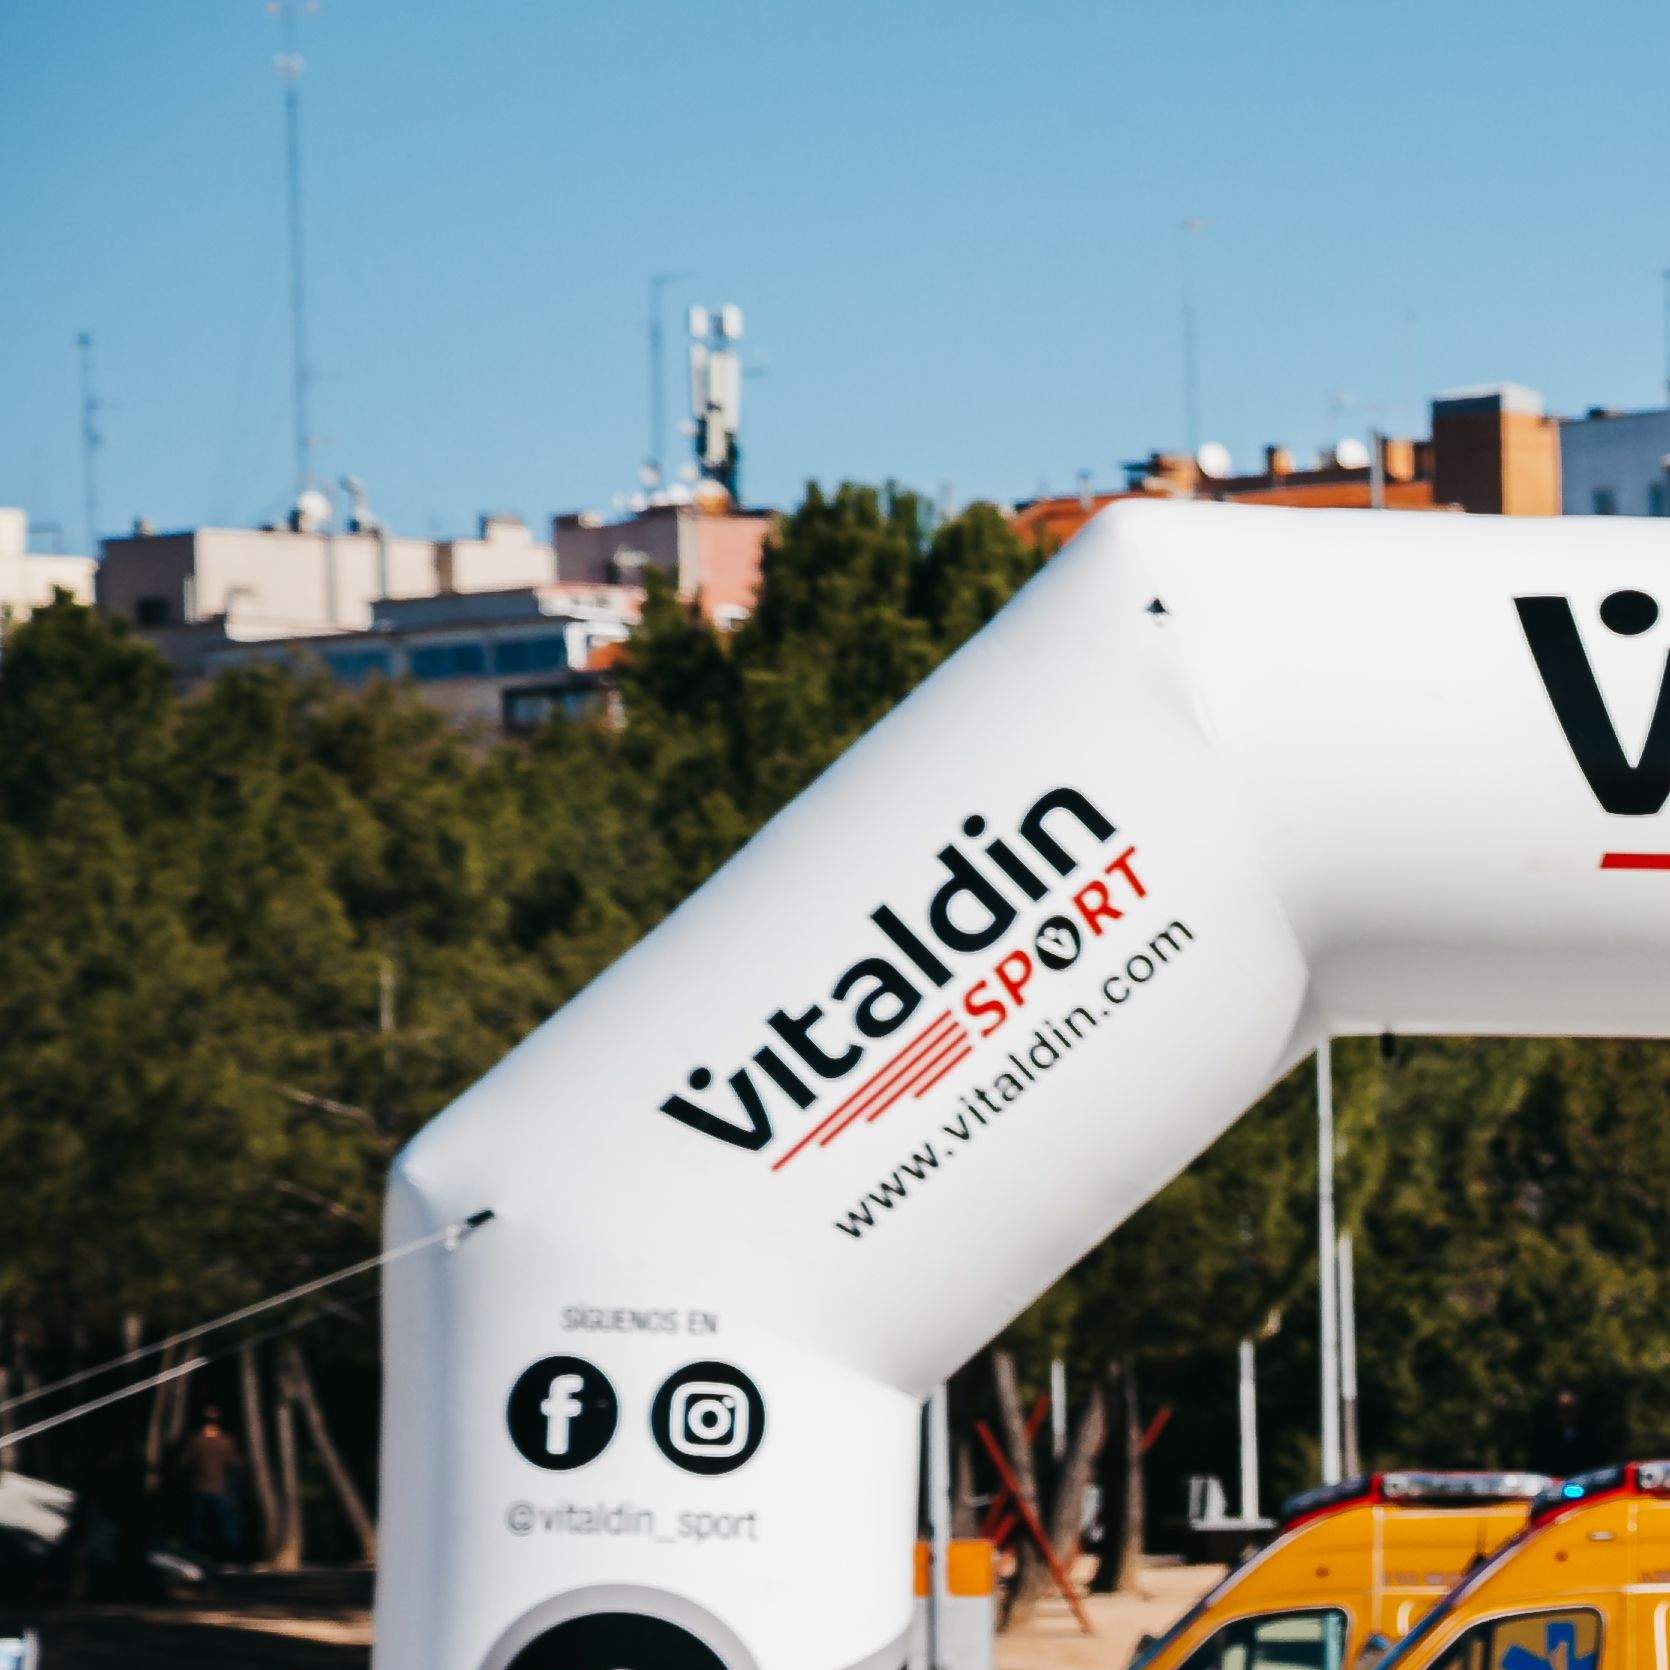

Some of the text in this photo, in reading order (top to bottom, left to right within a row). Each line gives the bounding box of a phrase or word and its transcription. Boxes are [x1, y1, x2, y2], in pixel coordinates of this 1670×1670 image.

[959, 844, 1153, 1040] SPORT
[832, 915, 1197, 1242] www.vitaldin.com
[688, 1310, 718, 1335] EN
[505, 1500, 758, 1544] @vitaldin_sport
